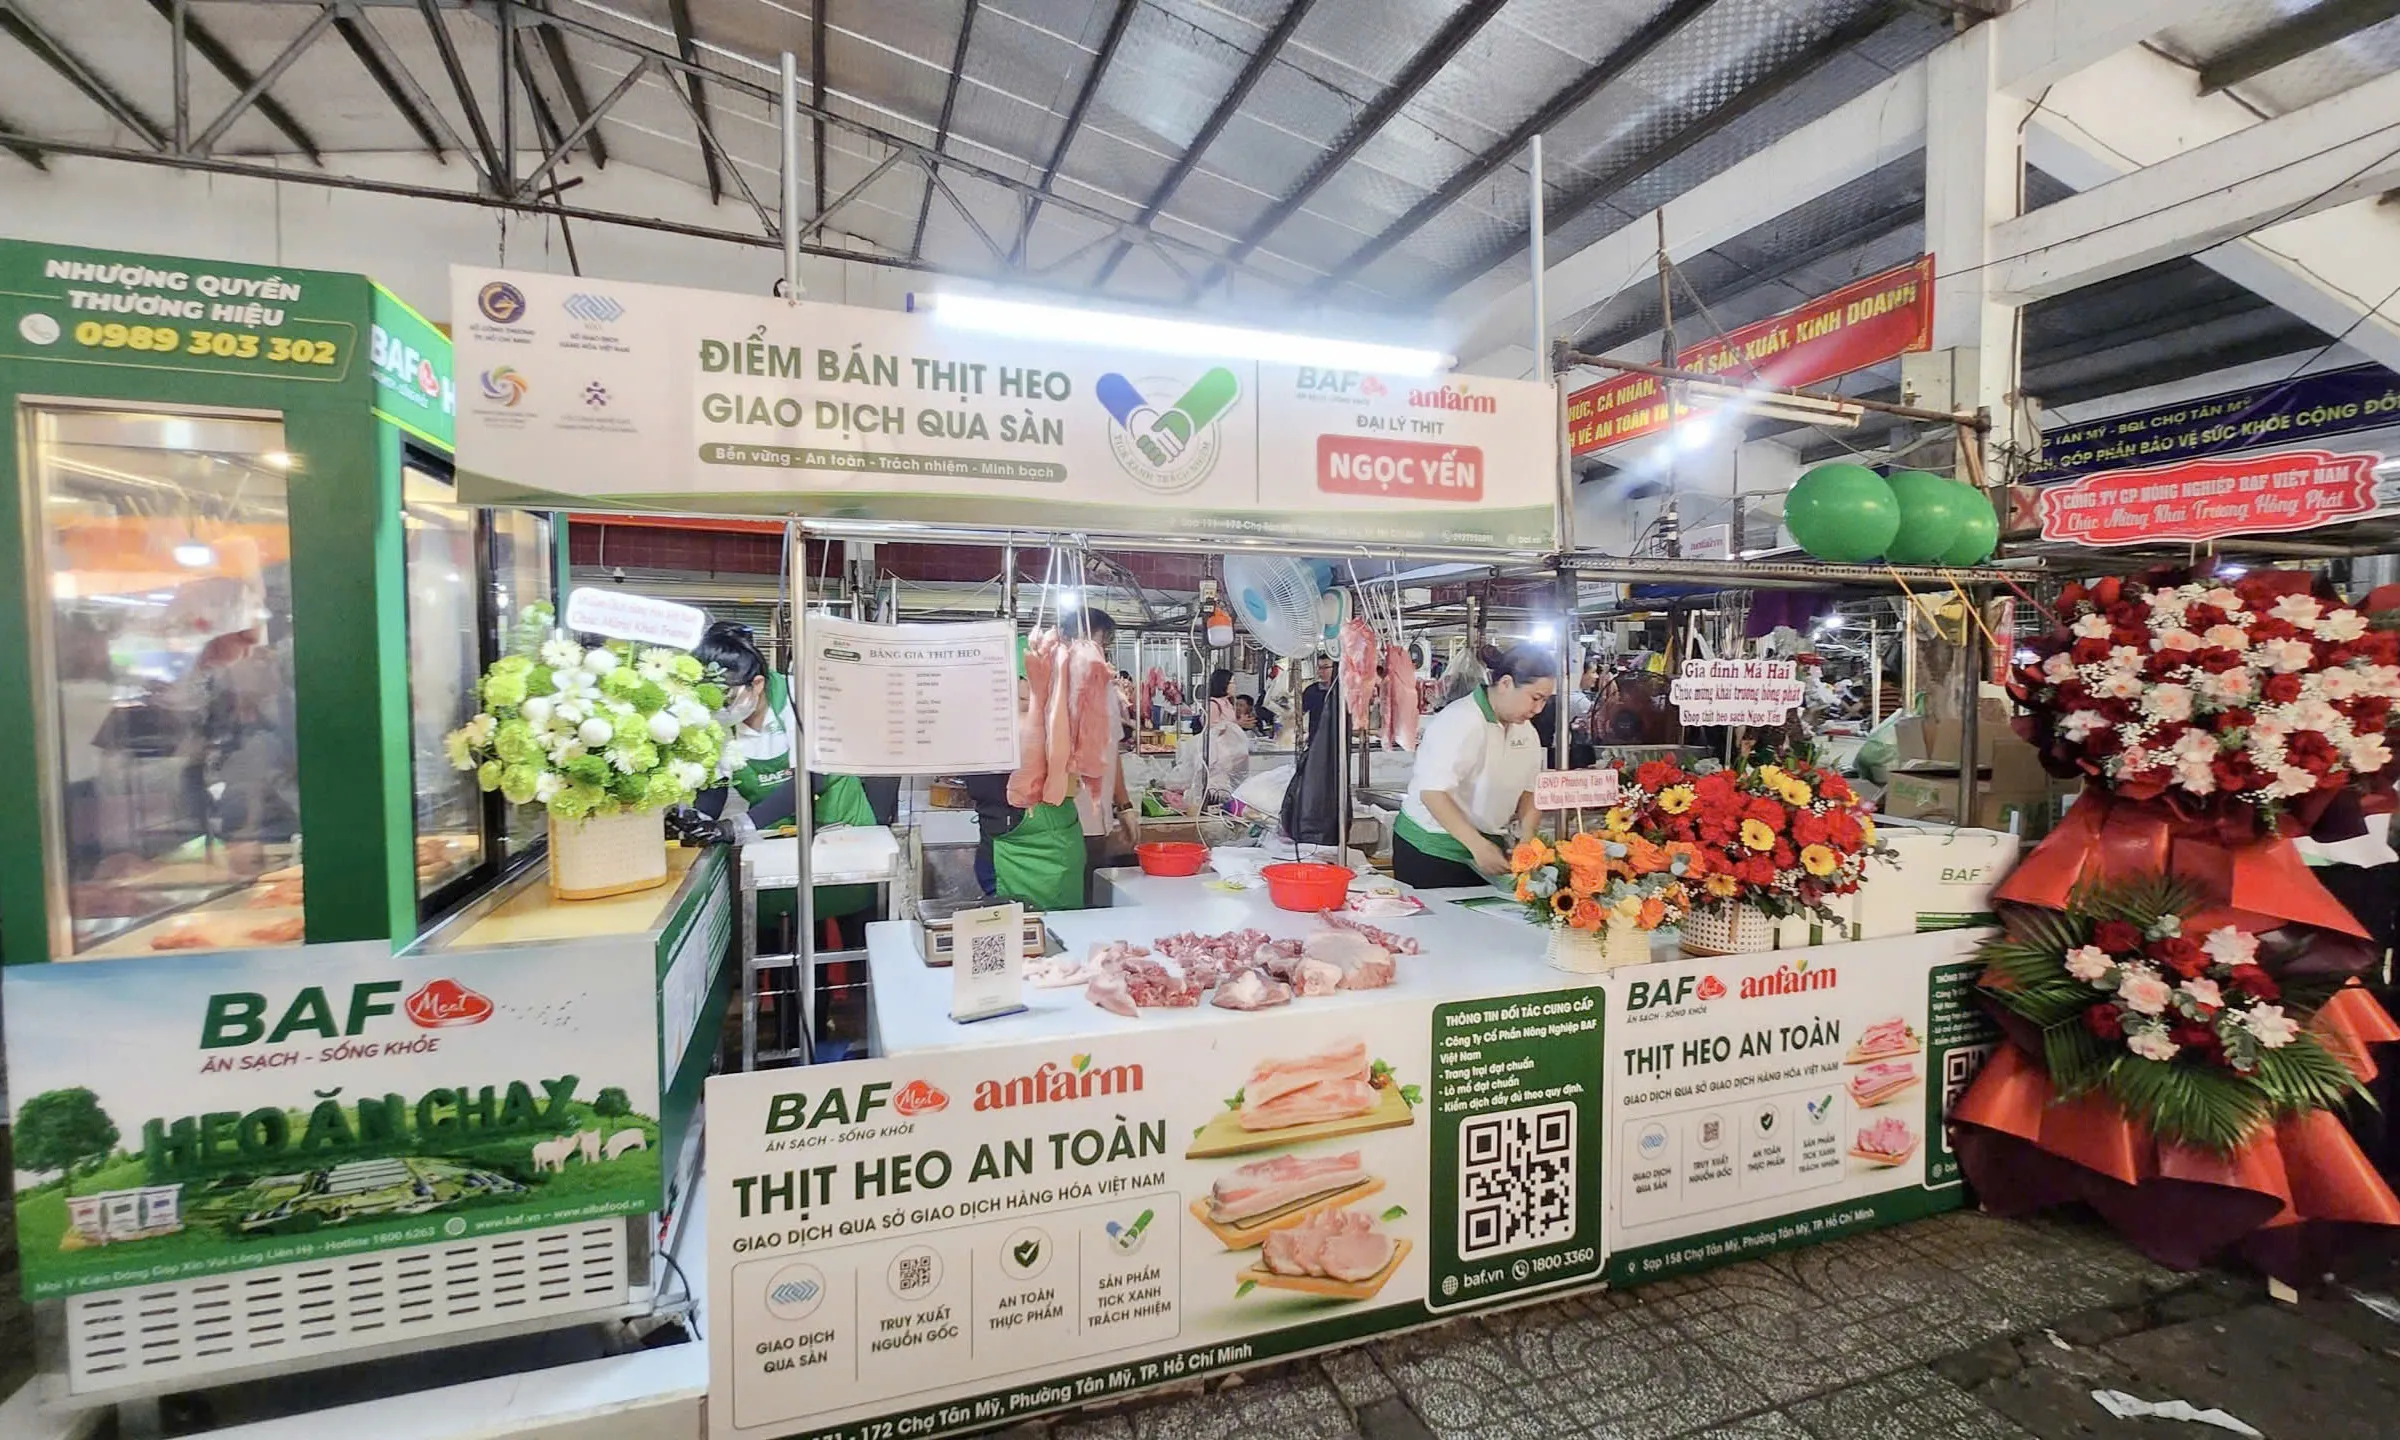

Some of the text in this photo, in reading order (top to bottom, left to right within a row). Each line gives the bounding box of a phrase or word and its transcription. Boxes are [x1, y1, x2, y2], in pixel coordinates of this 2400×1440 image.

[45, 259, 301, 302] NHƯỢNG QUYỀN
[68, 289, 284, 328] THƯƠNG HIỆU
[75, 321, 337, 365] 0989 303 302
[1707, 344, 1740, 374] SẢN
[1796, 309, 1842, 344] KINH
[1847, 281, 1918, 327] DOANH
[371, 324, 420, 382] BAF
[699, 324, 1071, 402] ĐIỂM BÁN THỊT HEO
[1296, 366, 1496, 414] BAF anfarm
[1597, 388, 1614, 412] CÁ
[702, 392, 1064, 445] GIAO DỊCH QUA SÀN
[1356, 414, 1444, 437] ĐẠI LÝ THỊT
[1595, 421, 1612, 441] AN
[1616, 408, 1650, 433] TOÀN
[2178, 430, 2199, 449] VỆ
[2202, 423, 2237, 444] SỨC
[2296, 403, 2359, 428] CỘNG
[1330, 449, 1475, 491] NGỌC YẾN
[2272, 469, 2309, 489] VIỆT
[2313, 465, 2349, 484] NAM
[957, 648, 981, 659] HEO
[1685, 662, 1706, 679] Gia
[1744, 662, 1762, 679] Má
[1767, 663, 1790, 679] Hai
[1940, 867, 1981, 881] BAF
[1626, 964, 1837, 1011] BAF anfarm
[199, 979, 468, 1050] BAF Meat
[1445, 996, 1594, 1027] THÔNG TIN ĐỐI TÁC CUNG CẤP
[1445, 1034, 1470, 1048] Công
[1472, 1033, 1482, 1046] Ty
[1499, 1026, 1522, 1040] Phần
[1523, 1025, 1547, 1039] Nông
[1548, 1021, 1579, 1037] Nghiệp
[1580, 1019, 1597, 1031] BAF
[1624, 1015, 1840, 1080] THỊT HEO AN TOÀN
[200, 1034, 441, 1074] ĂN SẠCH SỐNG KHỎE
[1440, 1049, 1481, 1066] Việt Nam
[1444, 1067, 1471, 1081] Trang
[765, 1061, 1144, 1135] BAF Meat anfarm
[1444, 1084, 1456, 1097] Lò
[1524, 1087, 1544, 1100] theo
[1545, 1086, 1562, 1099] quy
[143, 1073, 581, 1165] HEO ĂN CHAY
[789, 1135, 827, 1151] SẠCH
[838, 1127, 876, 1144] SỐNG
[880, 1121, 915, 1138] KHỎE
[732, 1113, 1166, 1221] THỊT HEO AN TOÀN
[732, 1171, 1165, 1254] GIAO DỊCH QUA SỞ GIAO DỊCH HÀNG HÓA VIỆT NAM
[1099, 1264, 1161, 1290] SẢN PHẨM
[1463, 1247, 1595, 1288] baf.vn 1800 3360
[999, 1287, 1055, 1310] AN TOÀN
[1098, 1285, 1162, 1309] TICK XANH
[880, 1303, 951, 1332] TRUY XUẤT
[989, 1300, 1064, 1331] THỰC PHẨM
[1088, 1300, 1172, 1328] TRÁCH NHIỆM
[756, 1329, 836, 1355] GIAO DỊCH
[871, 1323, 959, 1353] NGUỒN GỐC
[764, 1347, 828, 1373] QUA SÀN
[861, 1423, 894, 1440] 172
[898, 1413, 935, 1434] Chợ
[939, 1406, 971, 1424] Tân
[975, 1397, 1005, 1417] Mỹ,
[1010, 1384, 1071, 1411] Phường
[1075, 1376, 1105, 1395] Tân
[1108, 1368, 1136, 1389] Mỹ,
[1140, 1364, 1159, 1382] TP.
[1163, 1354, 1185, 1377] Hồ
[1188, 1349, 1214, 1369] Chí
[1217, 1343, 1253, 1363] Minh
